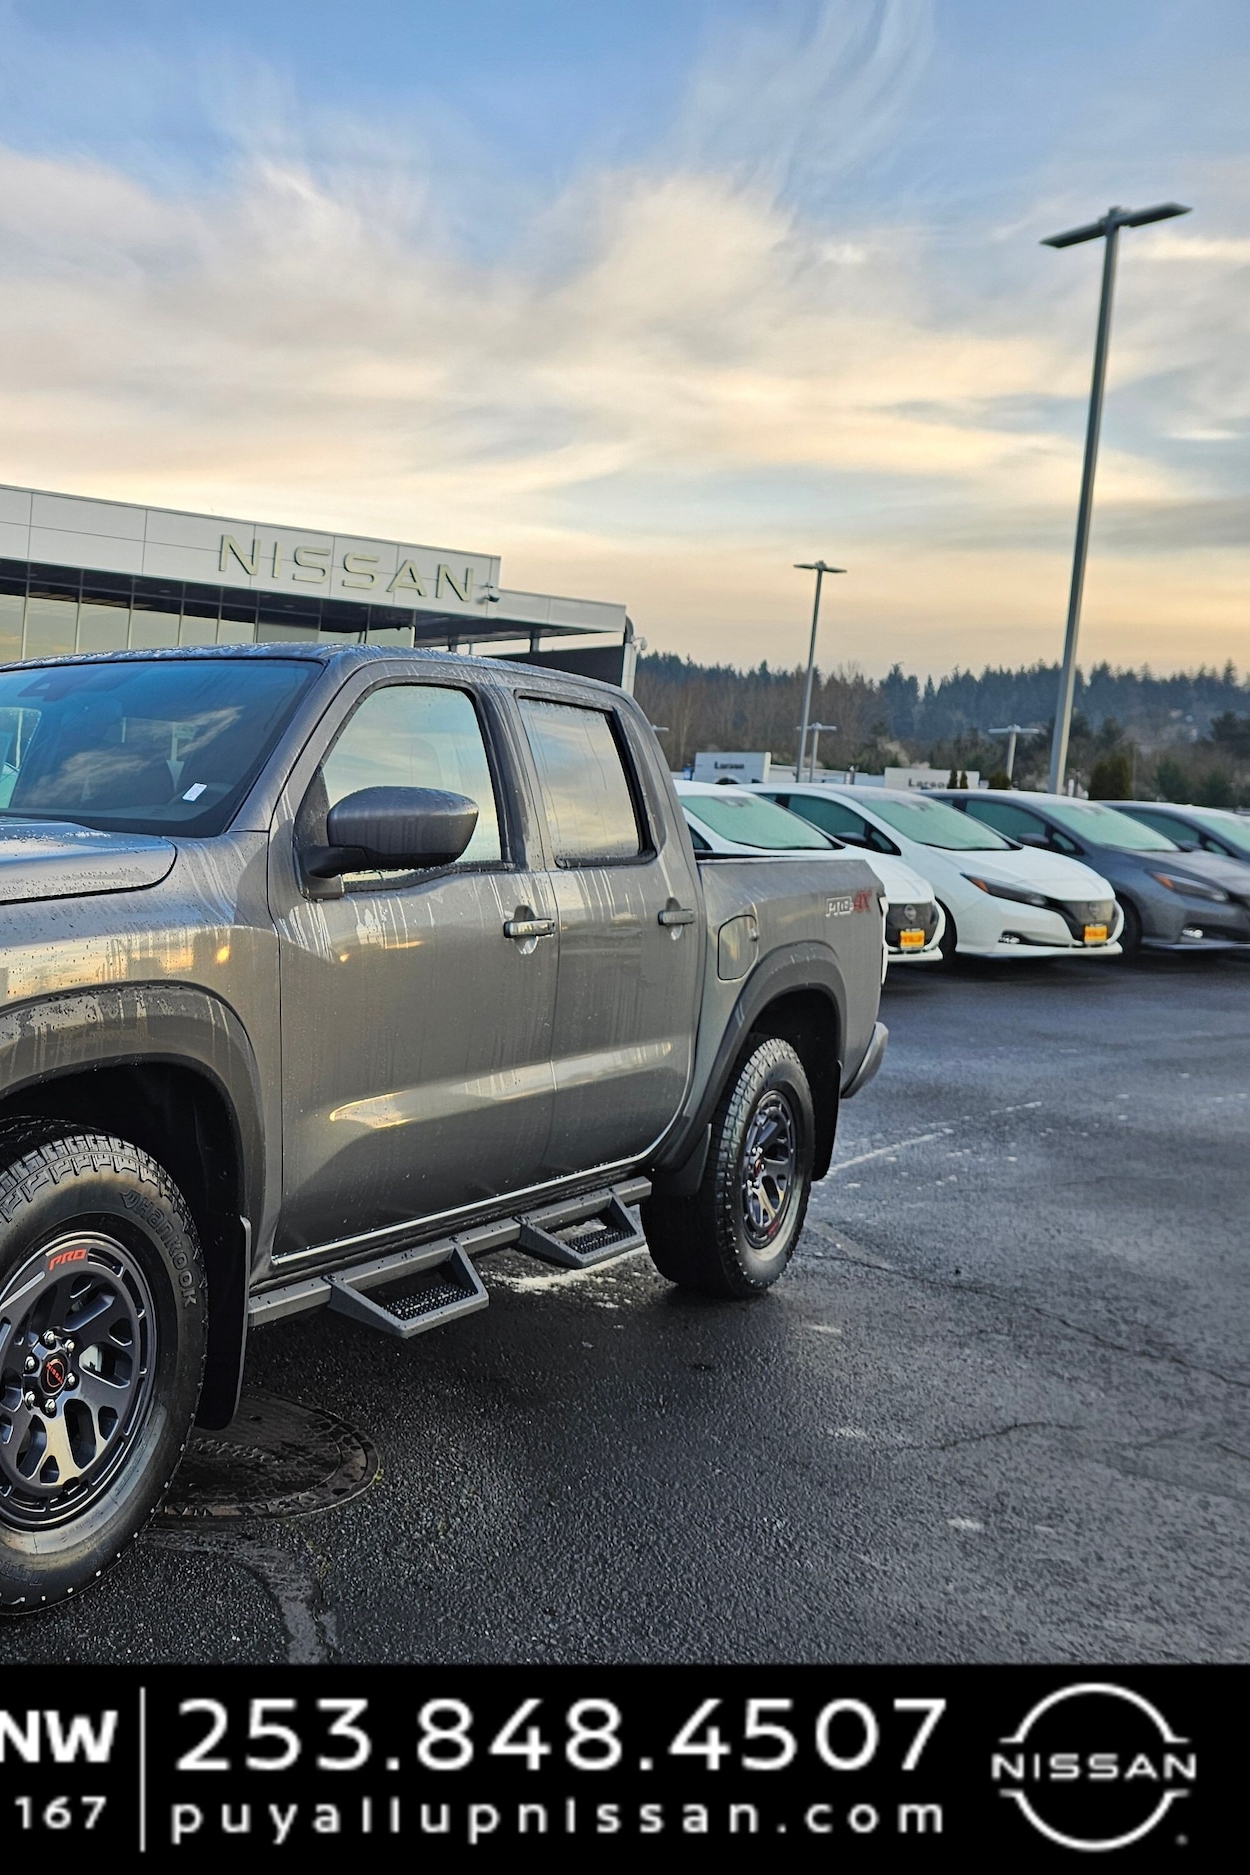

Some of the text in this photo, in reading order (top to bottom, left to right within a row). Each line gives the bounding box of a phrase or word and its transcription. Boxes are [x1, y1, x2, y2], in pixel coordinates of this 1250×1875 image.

[218, 534, 475, 602] NISSAN
[48, 1248, 87, 1271] PRO
[134, 1196, 197, 1308] Hankook
